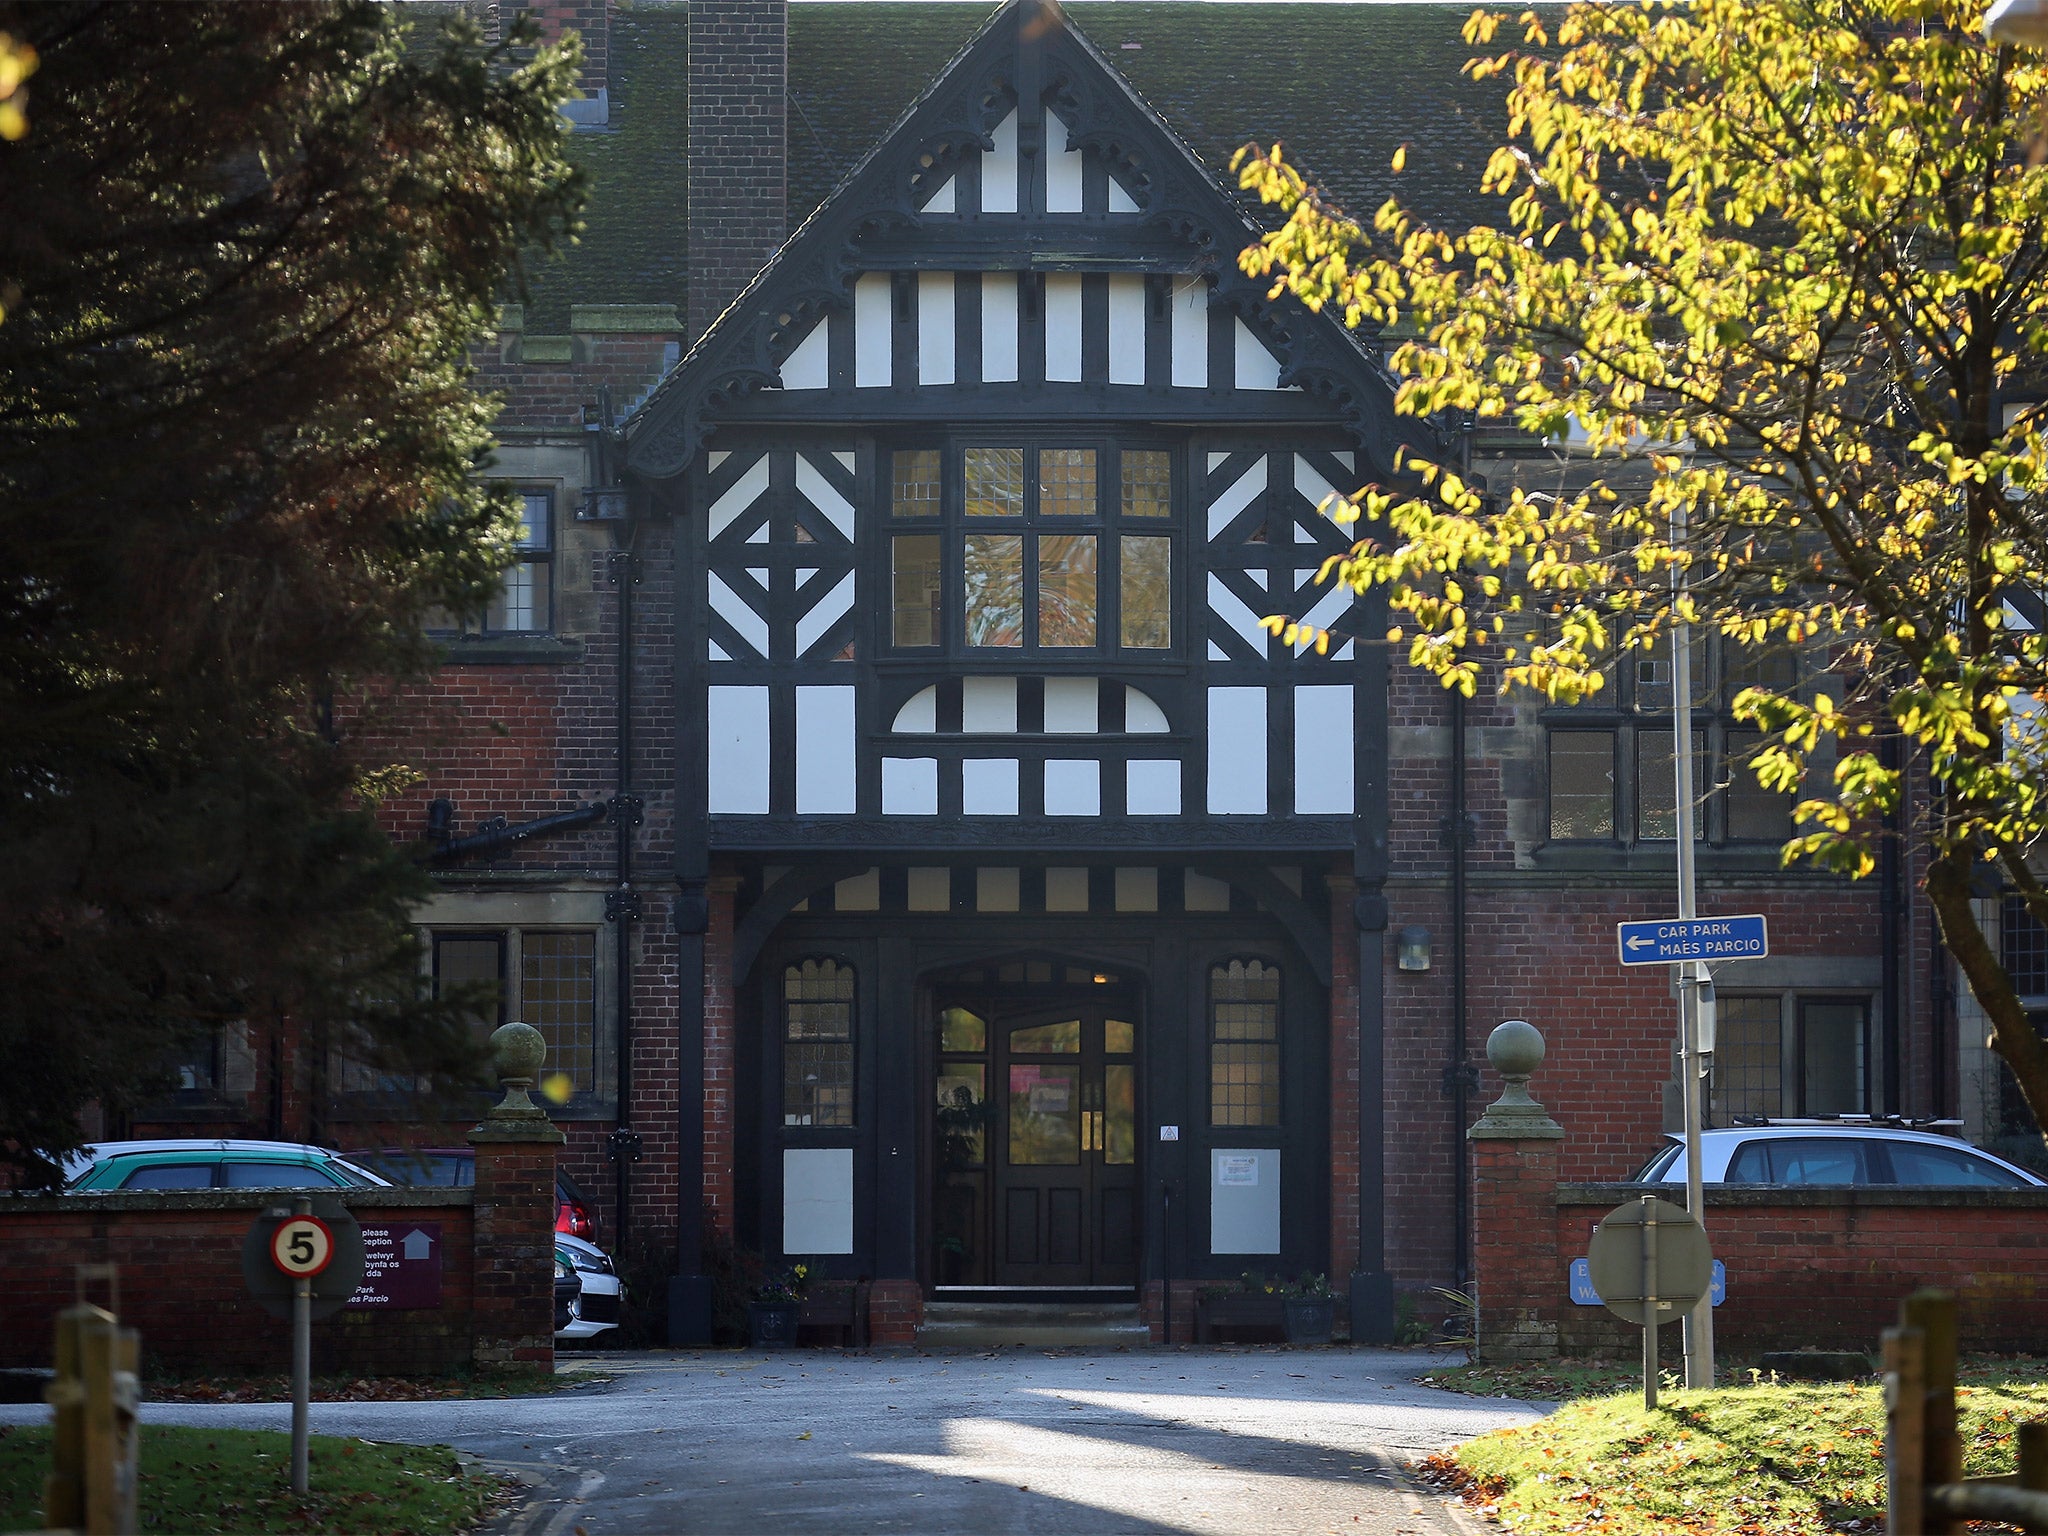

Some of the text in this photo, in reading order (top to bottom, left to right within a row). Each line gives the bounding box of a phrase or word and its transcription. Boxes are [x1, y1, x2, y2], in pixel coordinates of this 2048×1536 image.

[1658, 923, 1731, 938] CAR PARK
[1660, 939, 1760, 955] MAES PARCIO
[361, 1229, 389, 1238] please
[287, 1231, 315, 1265] 5
[355, 1286, 375, 1294] Park
